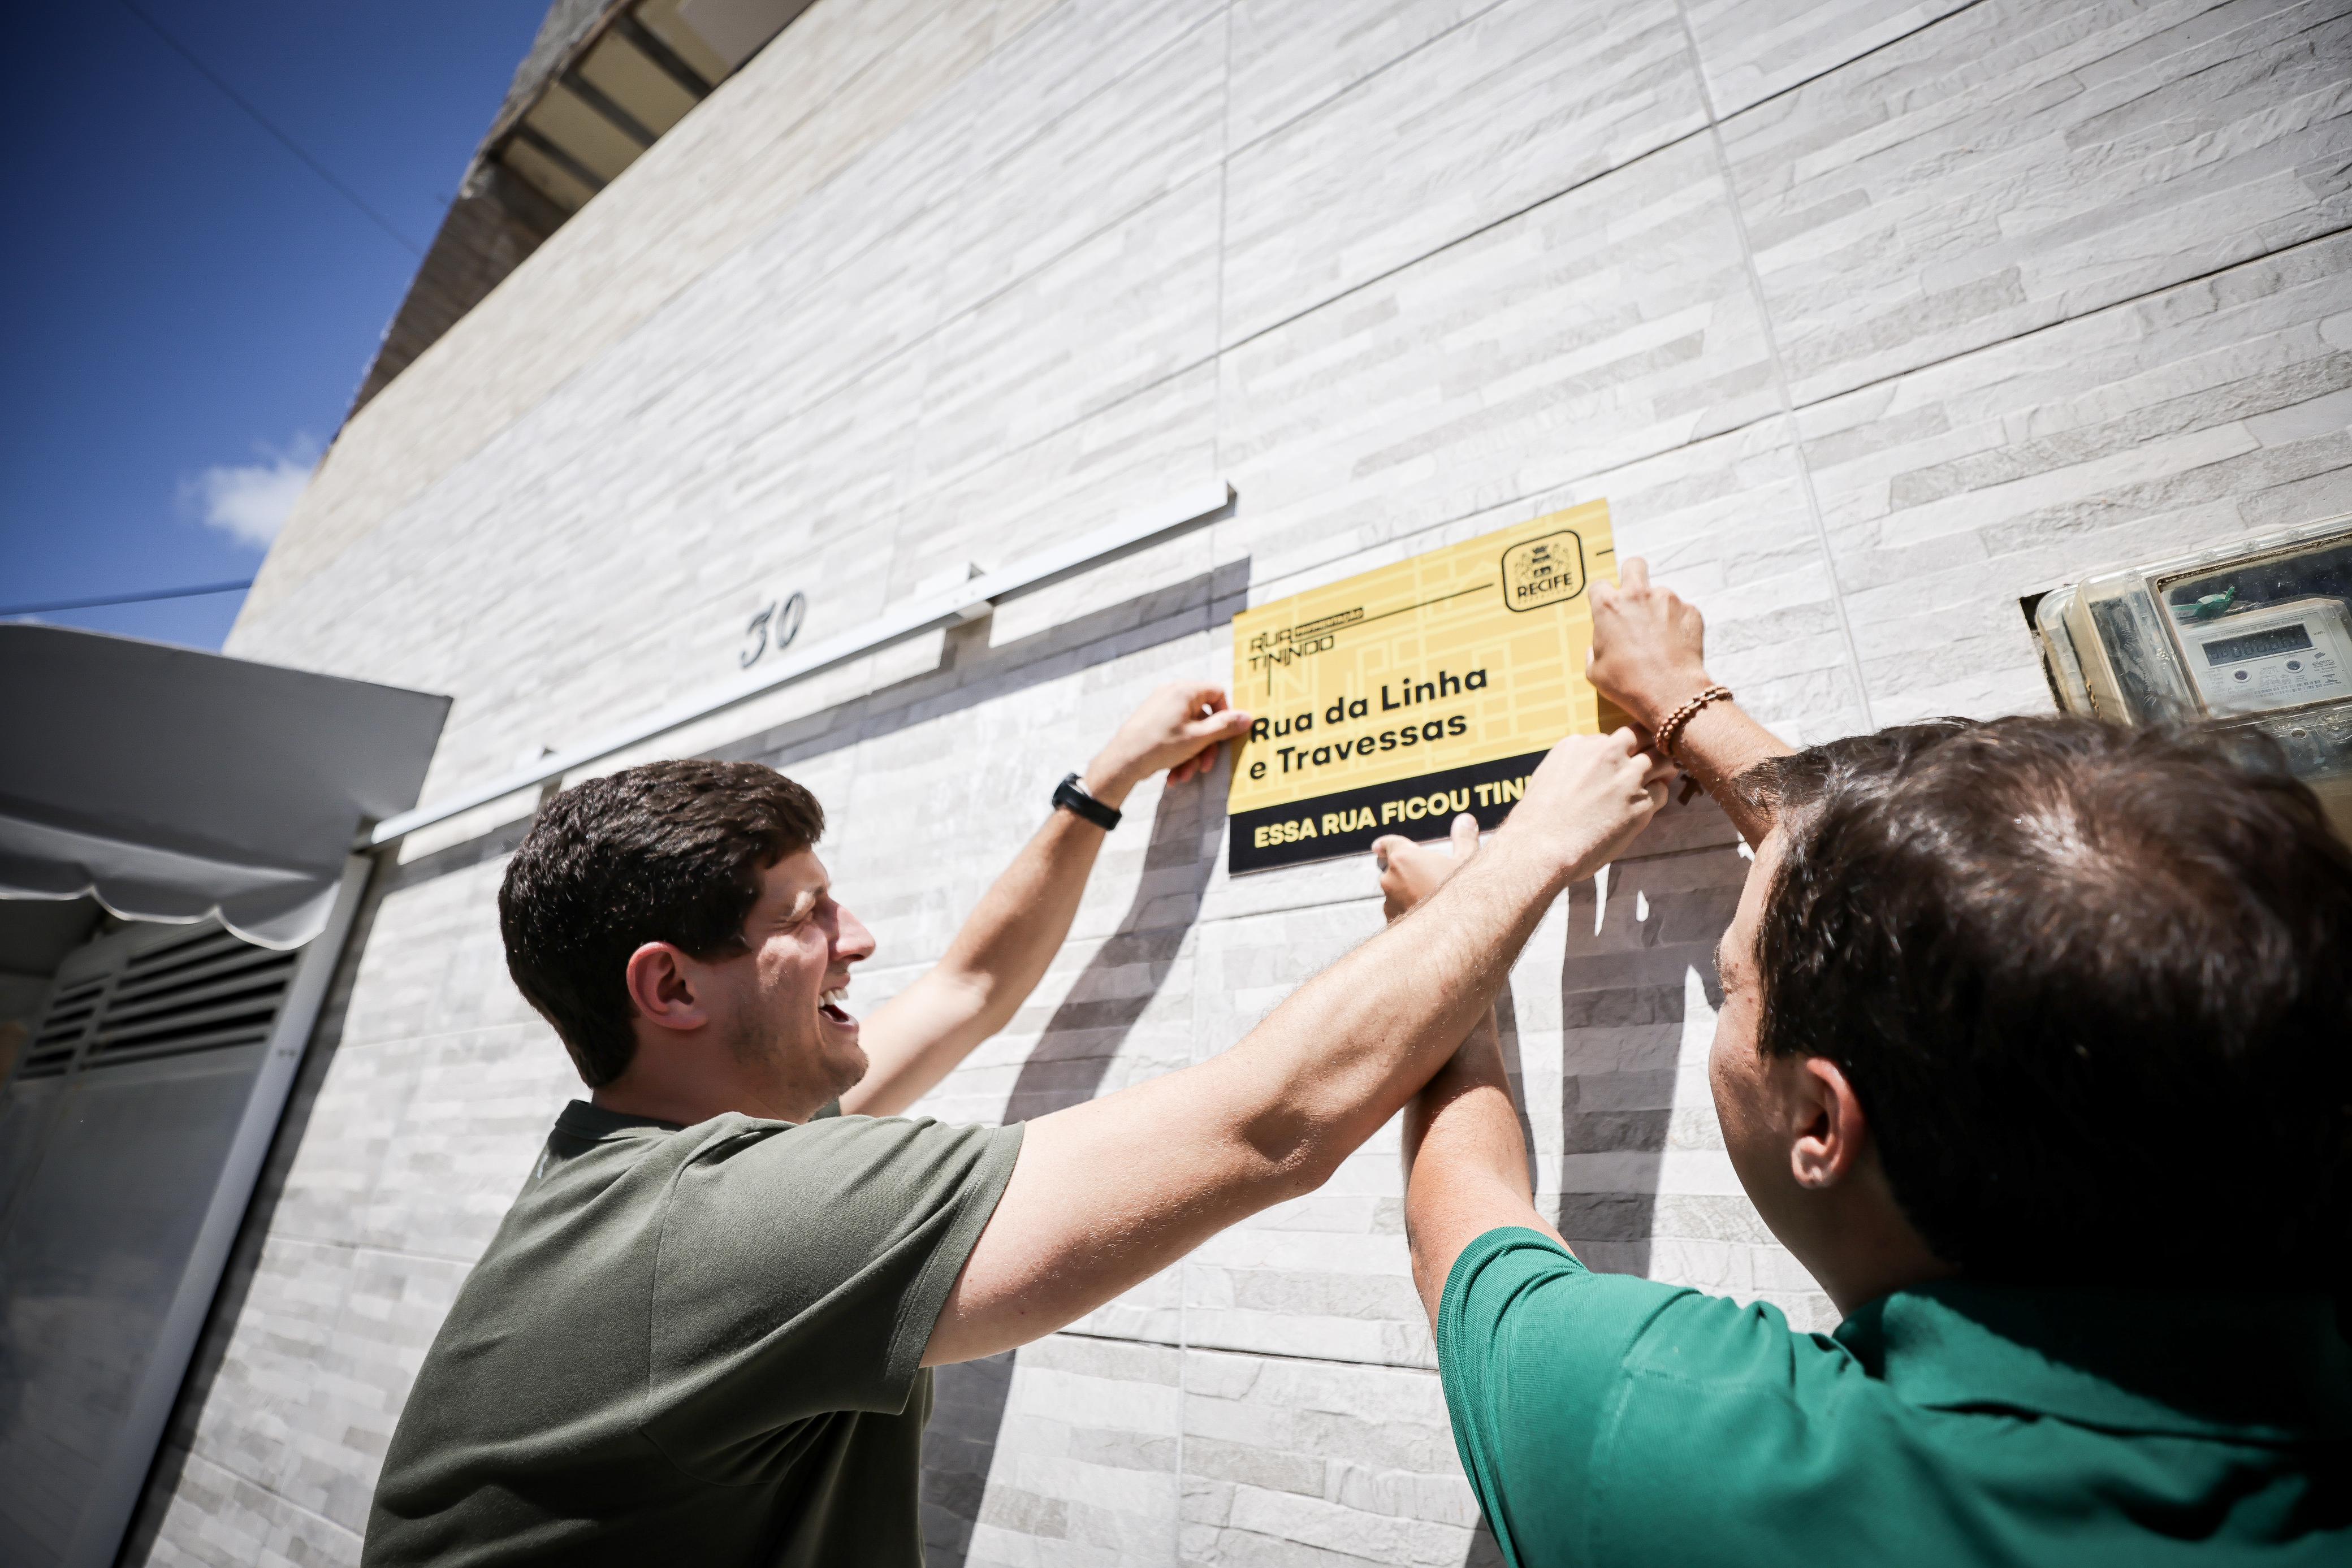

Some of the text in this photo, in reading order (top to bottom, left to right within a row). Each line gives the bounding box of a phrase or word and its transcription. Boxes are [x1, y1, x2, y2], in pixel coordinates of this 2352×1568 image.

[1517, 572, 1572, 597] RECIFE
[1251, 669, 1488, 743] Rua da Linha
[1249, 714, 1467, 780] e Travessas
[1254, 817, 1318, 848] ESSA
[1321, 807, 1377, 836] RUA
[1381, 787, 1471, 825] FICOU
